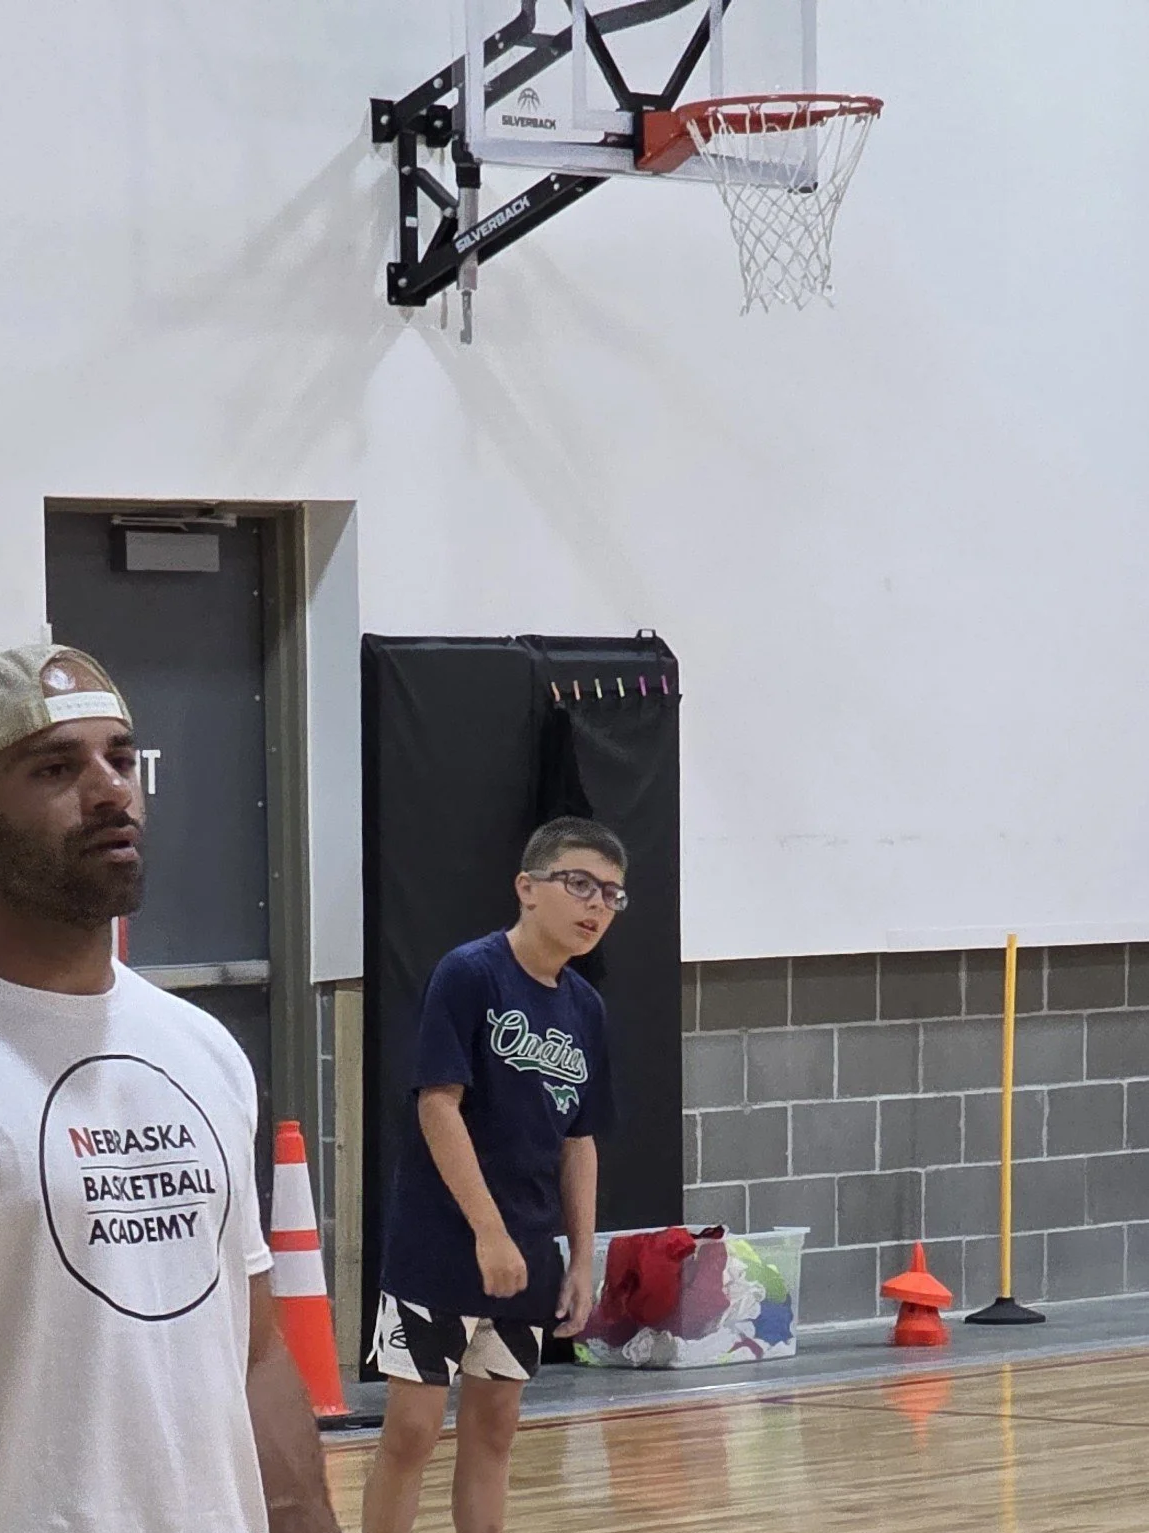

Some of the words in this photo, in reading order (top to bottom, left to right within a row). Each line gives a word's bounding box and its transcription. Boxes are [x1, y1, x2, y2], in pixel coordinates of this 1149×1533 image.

[454, 195, 531, 254] SILVERBACK
[68, 1124, 197, 1158] NEBRASKA
[82, 1168, 217, 1203] BASKETBALL
[87, 1211, 199, 1246] ACADEMY
